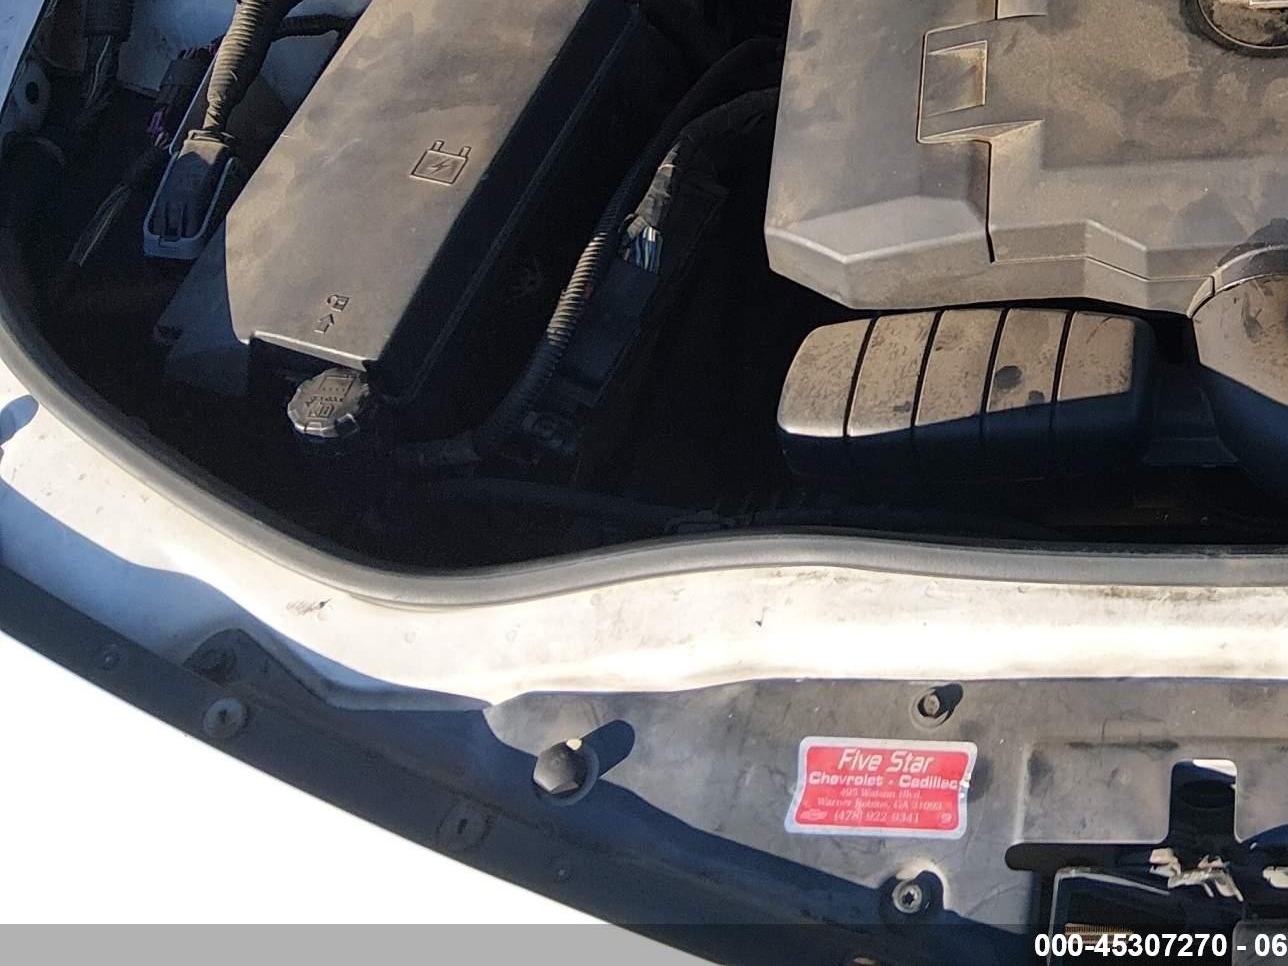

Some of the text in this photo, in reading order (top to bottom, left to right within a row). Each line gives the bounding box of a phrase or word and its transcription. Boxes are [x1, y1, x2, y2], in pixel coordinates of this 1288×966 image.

[837, 747, 935, 774] Five Star
[809, 771, 884, 786] Chevrolet
[899, 775, 959, 789] Cadillac
